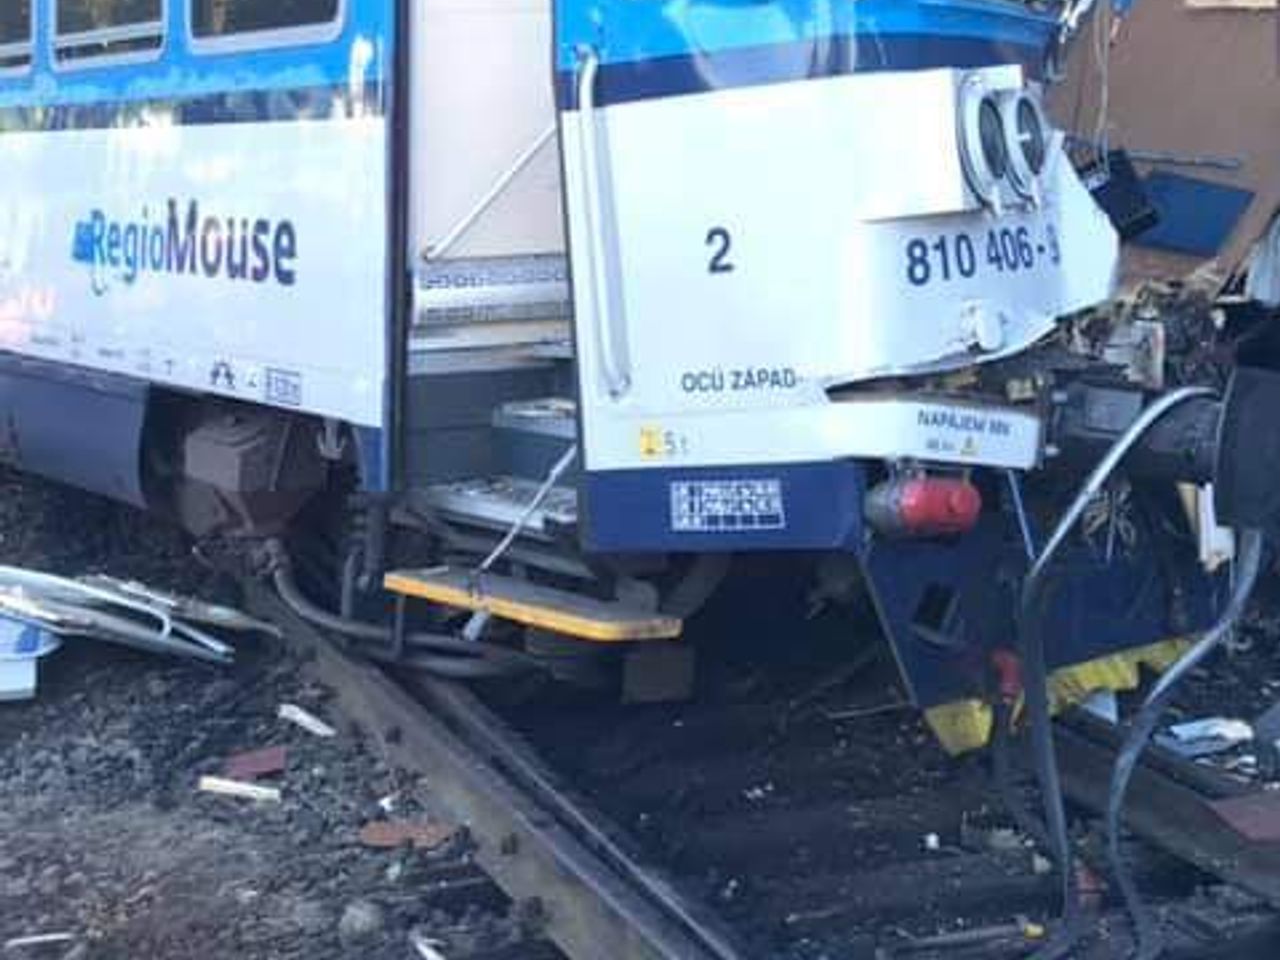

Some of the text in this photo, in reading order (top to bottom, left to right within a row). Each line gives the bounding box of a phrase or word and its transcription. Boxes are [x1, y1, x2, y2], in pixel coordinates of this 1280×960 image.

[88, 197, 299, 287] RegioMouse
[705, 226, 735, 274] 2
[906, 233, 976, 287] 810
